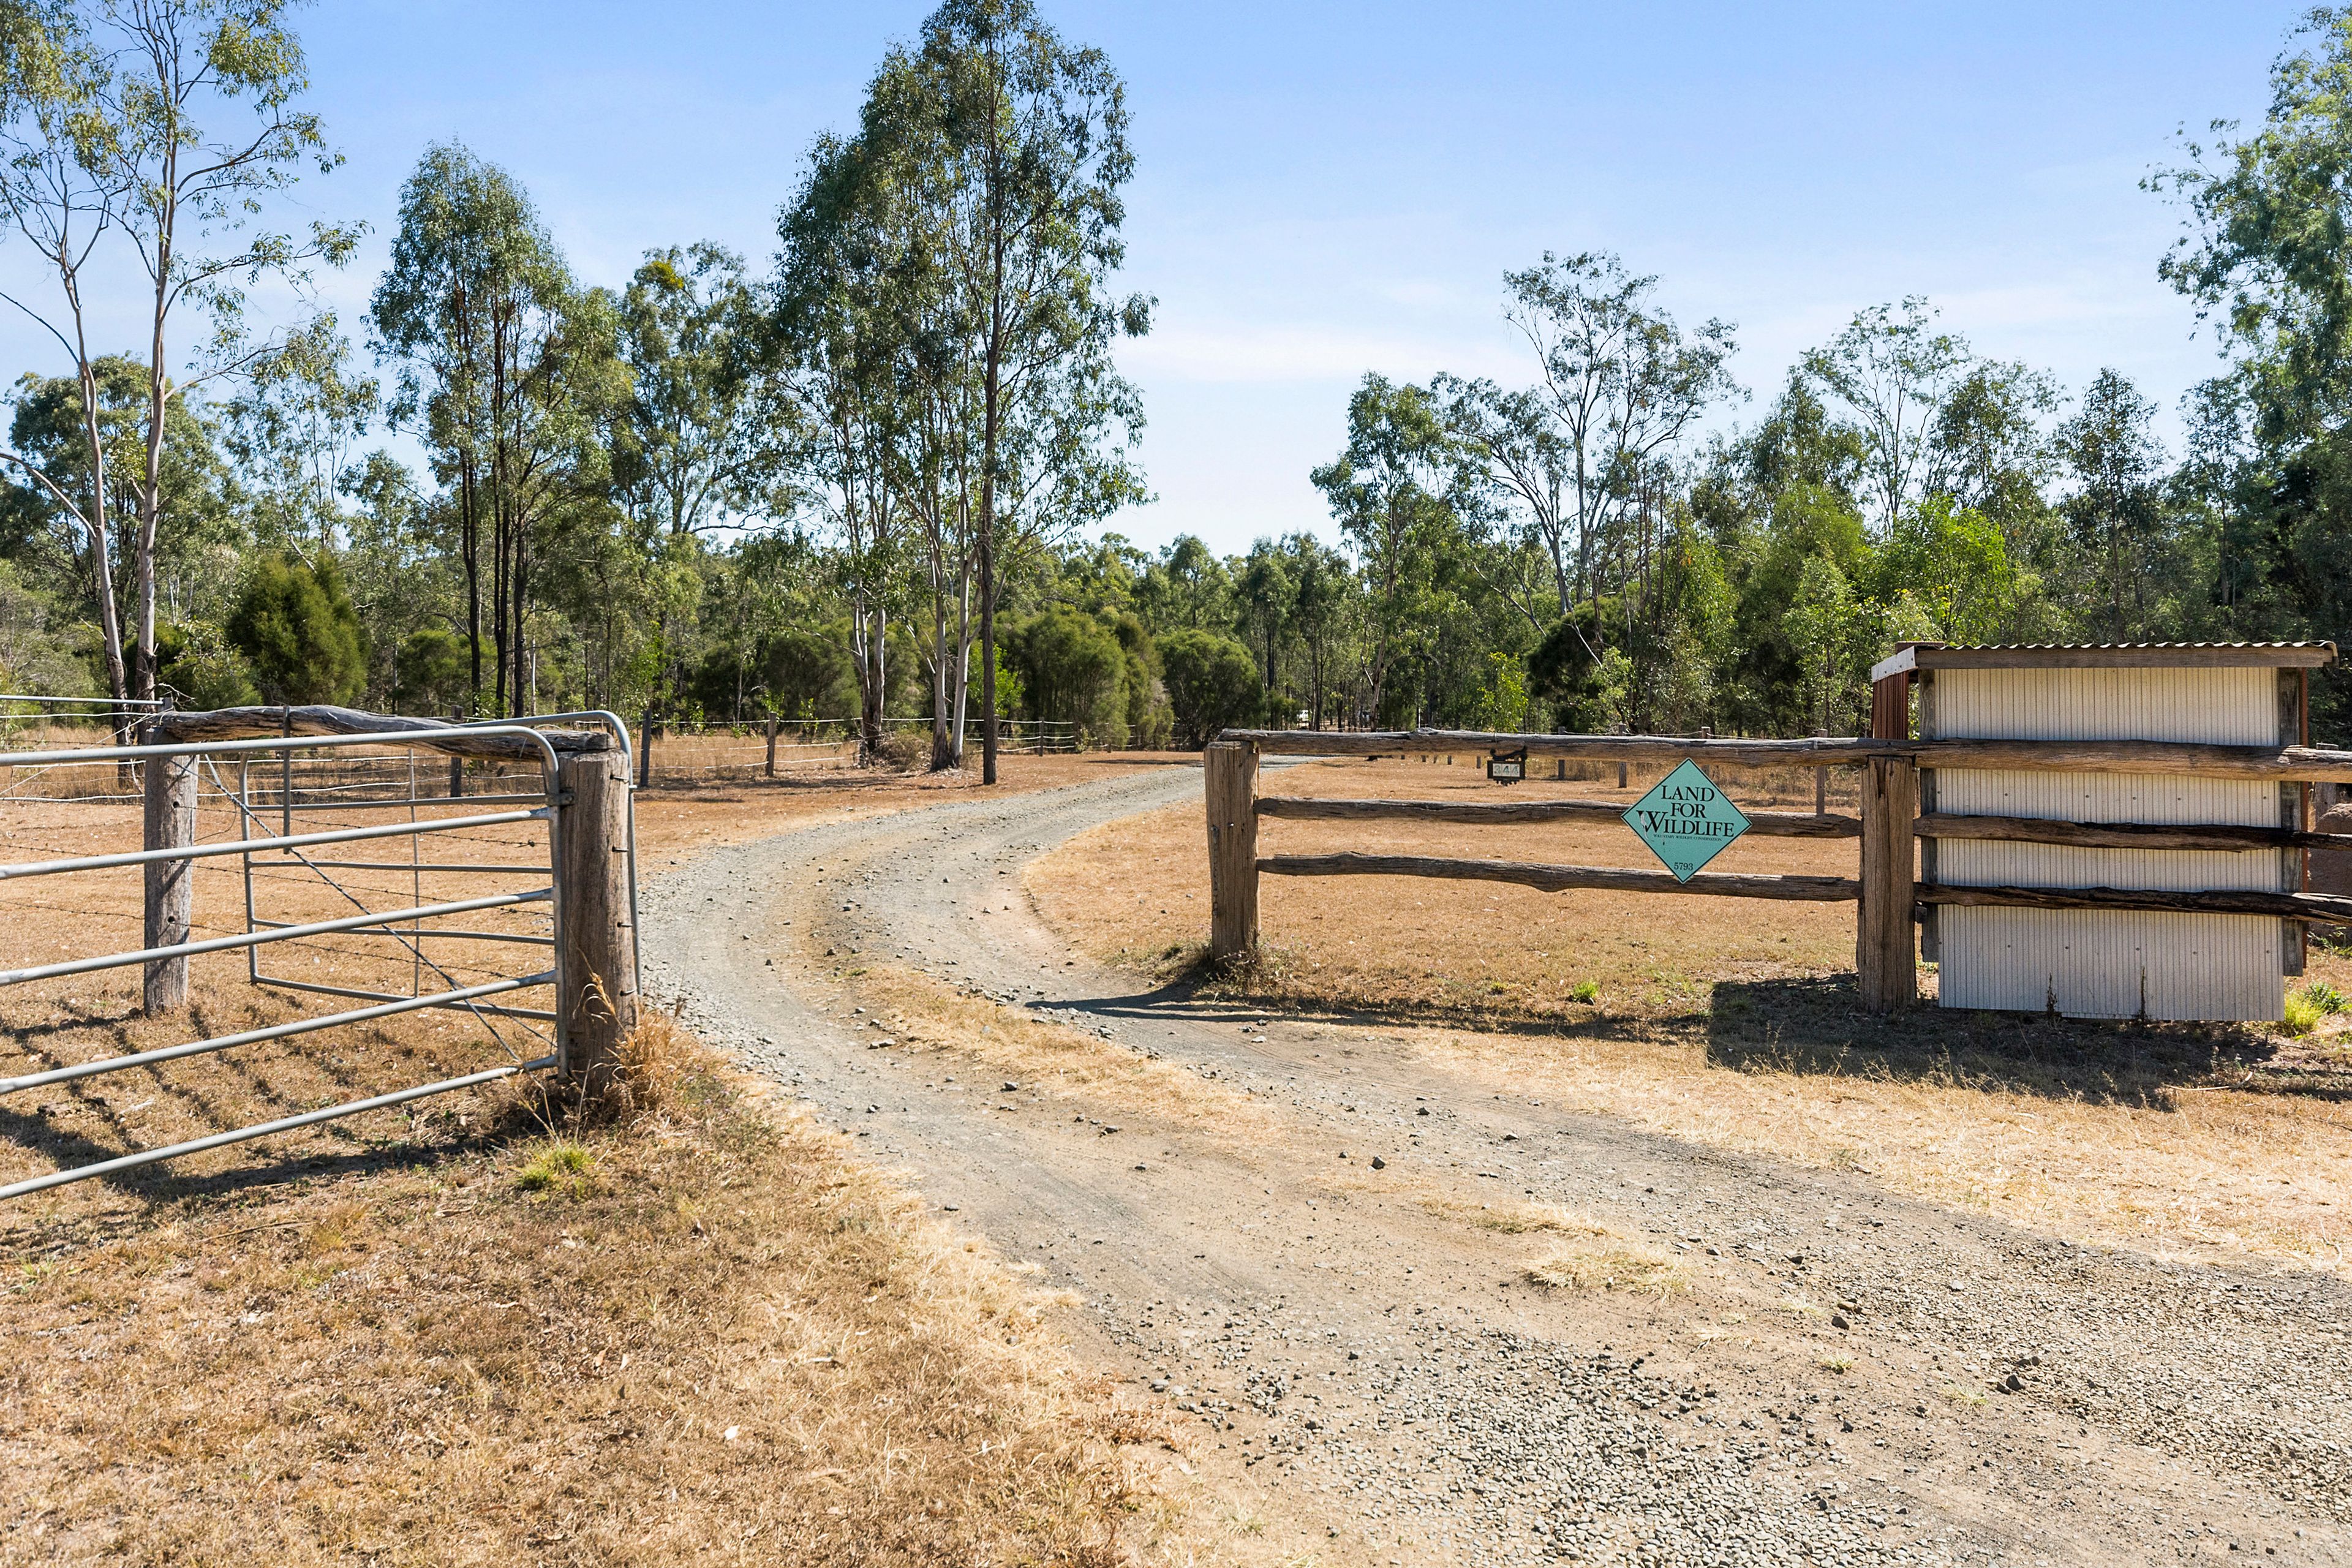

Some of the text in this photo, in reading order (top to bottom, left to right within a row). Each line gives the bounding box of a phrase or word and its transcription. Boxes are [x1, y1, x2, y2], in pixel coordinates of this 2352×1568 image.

[1661, 785, 1715, 802] LAND
[1670, 802, 1707, 818] FOR
[1636, 810, 1735, 837] WILDLIFE
[1674, 862, 1694, 870] 5793
